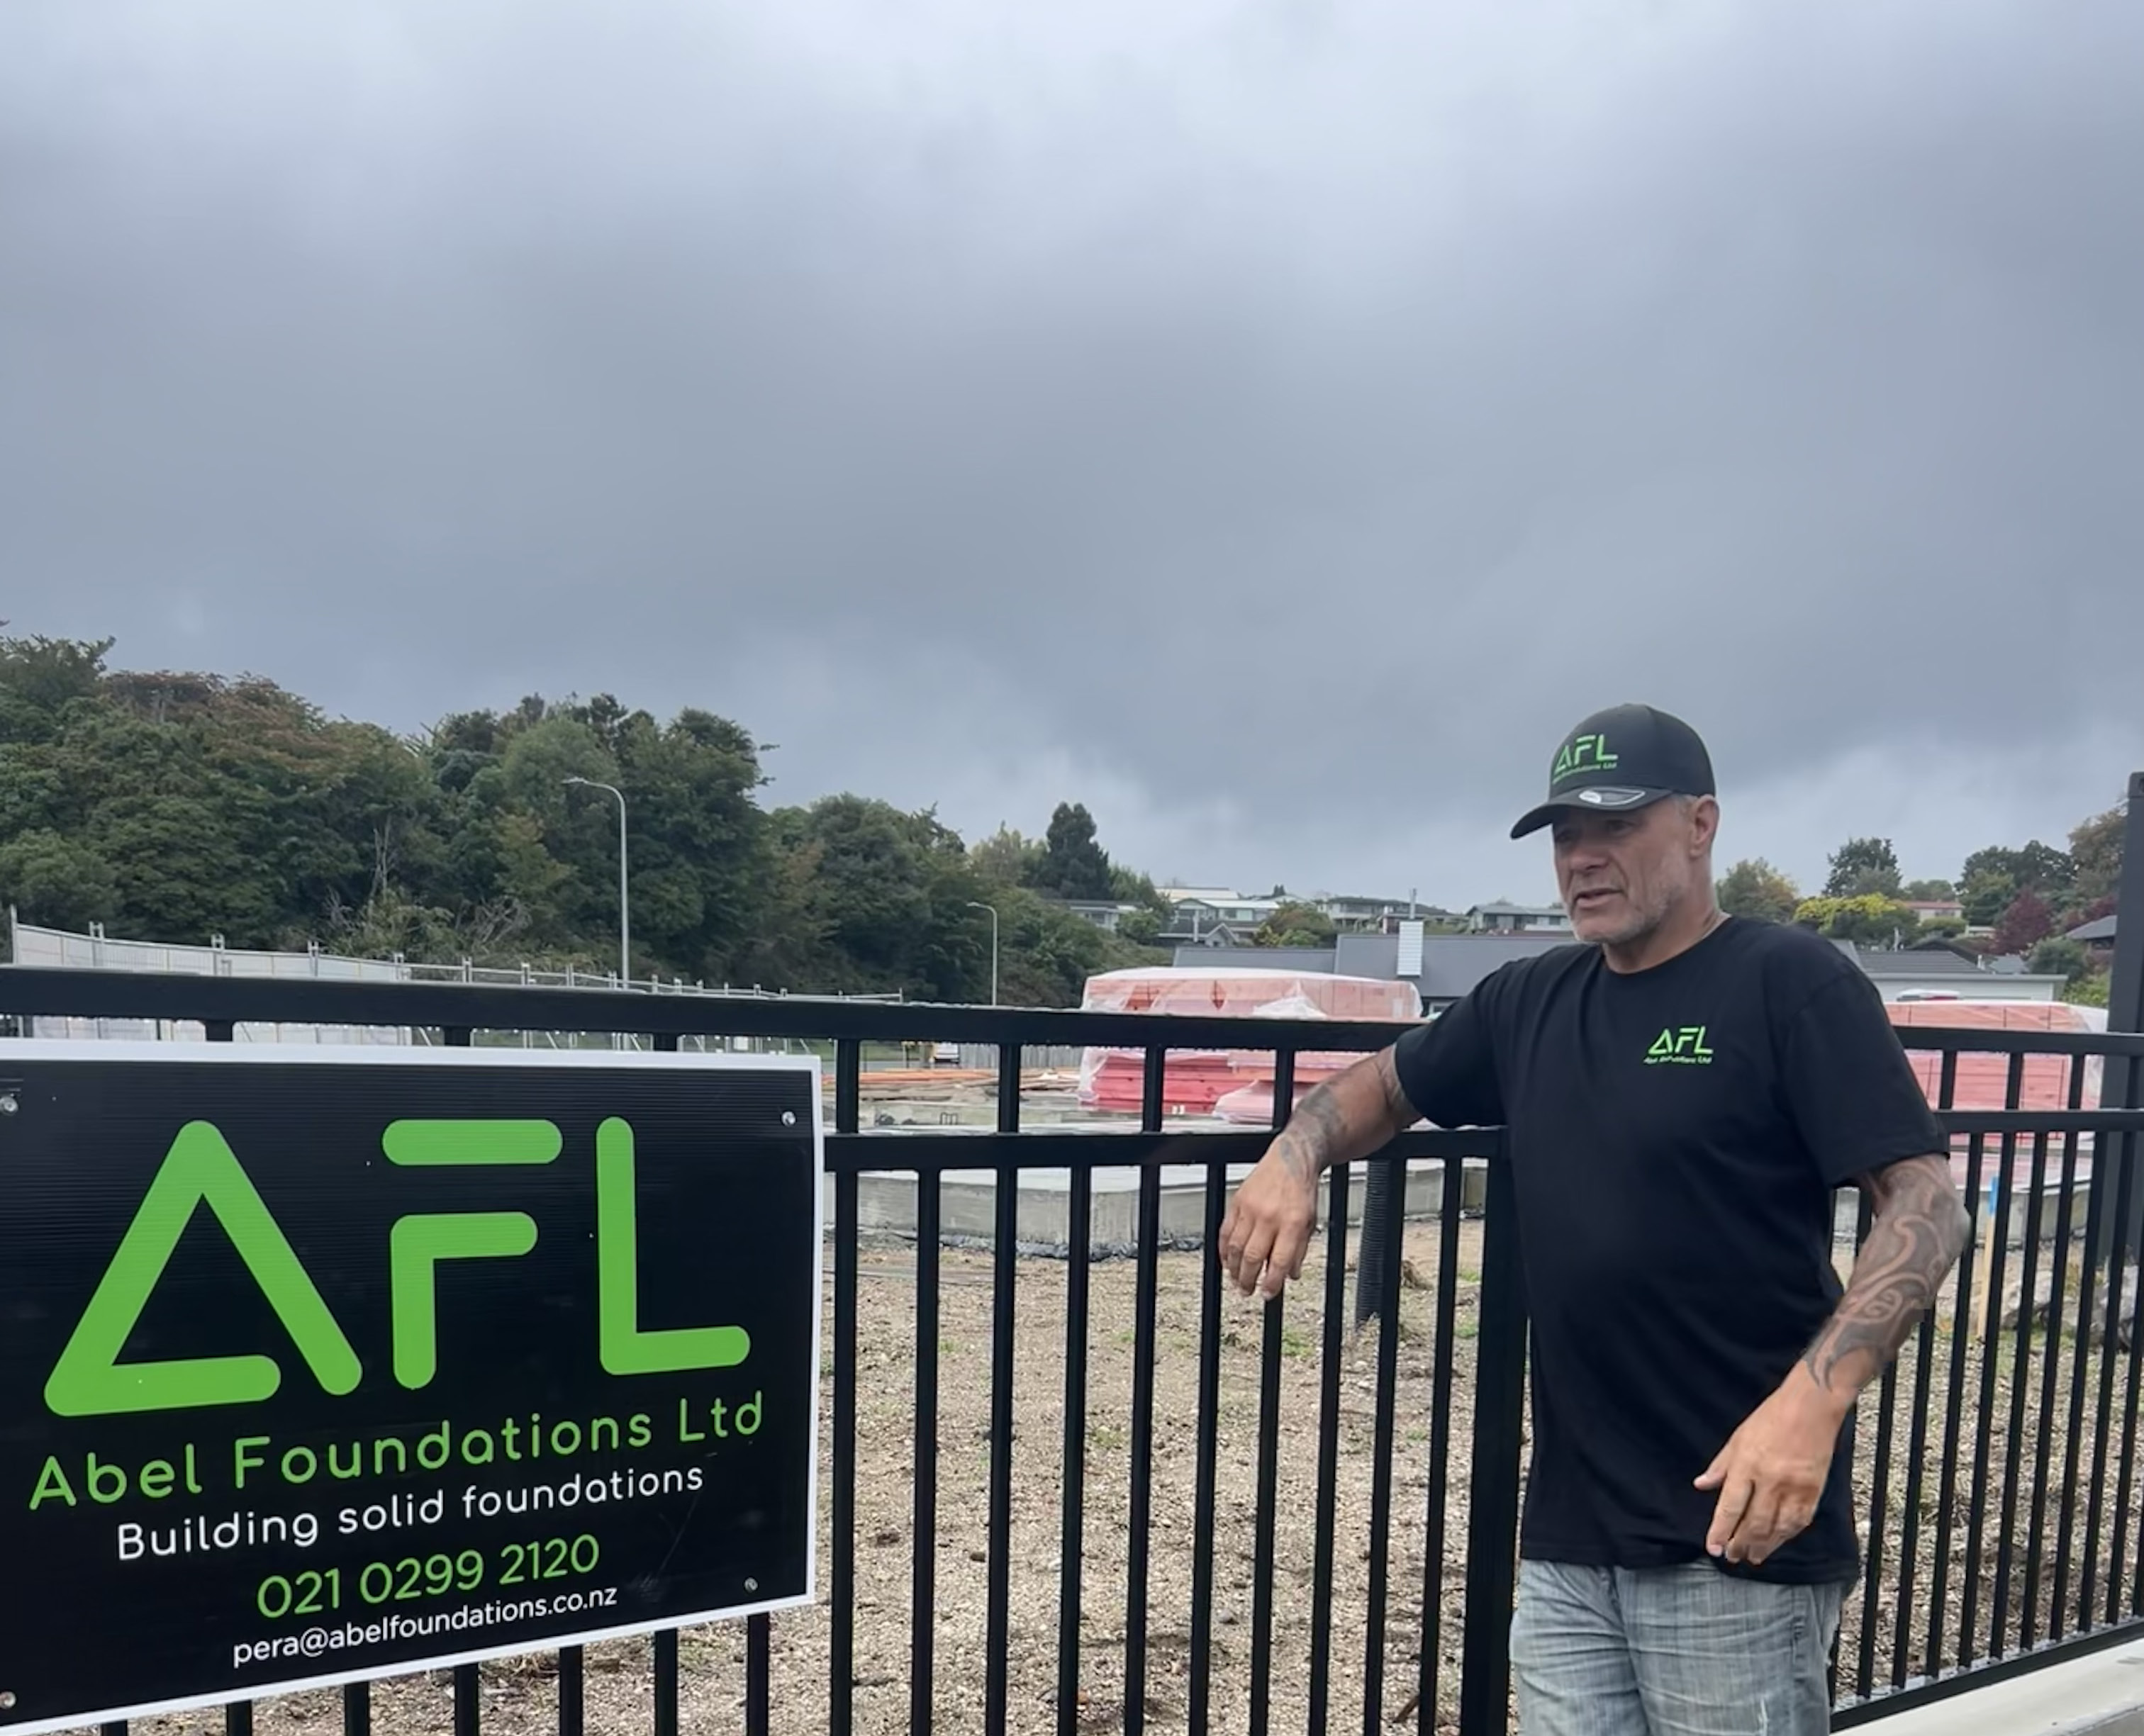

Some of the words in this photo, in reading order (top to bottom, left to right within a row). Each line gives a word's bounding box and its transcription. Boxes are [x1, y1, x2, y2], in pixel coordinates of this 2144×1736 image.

[1553, 733, 1619, 775] AFL
[1648, 1025, 1714, 1055] AFL
[44, 1116, 750, 1417] AFL
[29, 1443, 202, 1510] Abel
[235, 1413, 651, 1489] Foundations
[680, 1391, 761, 1441] Ltd
[118, 1512, 318, 1560] Building
[338, 1489, 443, 1534] solid
[462, 1467, 703, 1518] foundations
[257, 1568, 339, 1618] 021
[360, 1550, 483, 1603] 0299
[499, 1534, 599, 1587] 2120
[233, 1587, 618, 1669] pera@abelfoundations.co.nz
